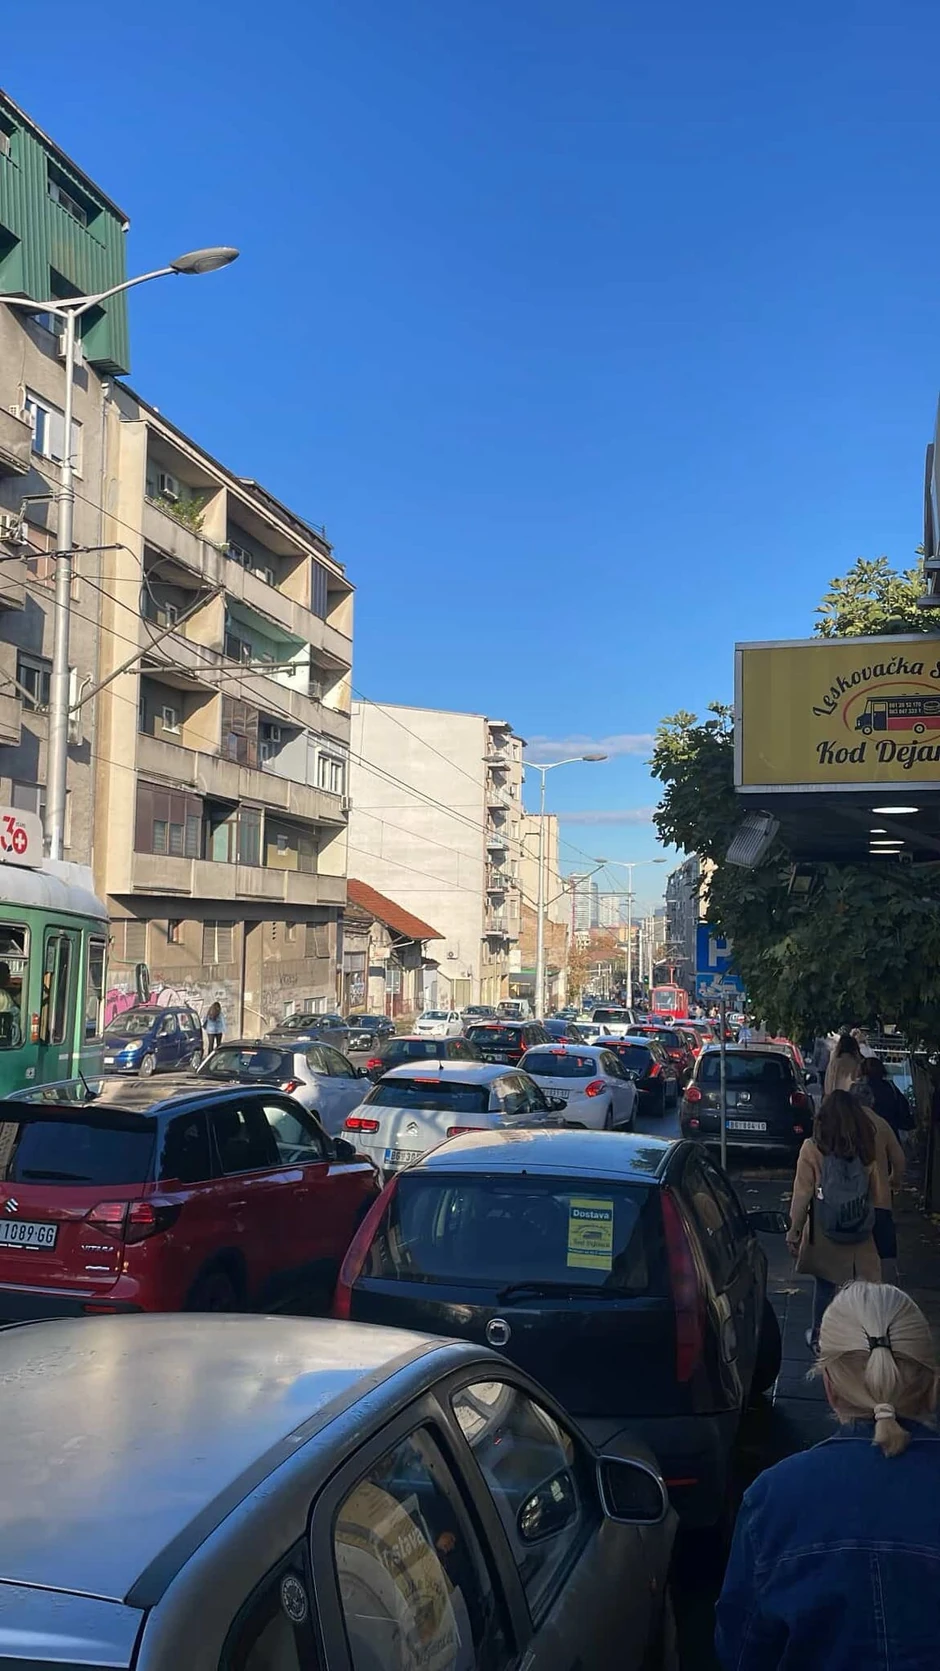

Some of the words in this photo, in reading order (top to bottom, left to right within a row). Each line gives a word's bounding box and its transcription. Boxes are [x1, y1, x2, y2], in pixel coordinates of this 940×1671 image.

[812, 656, 924, 716] Leskovačka
[816, 741, 867, 764] Kod
[708, 933, 734, 967] P
[573, 1209, 610, 1219] Dostava
